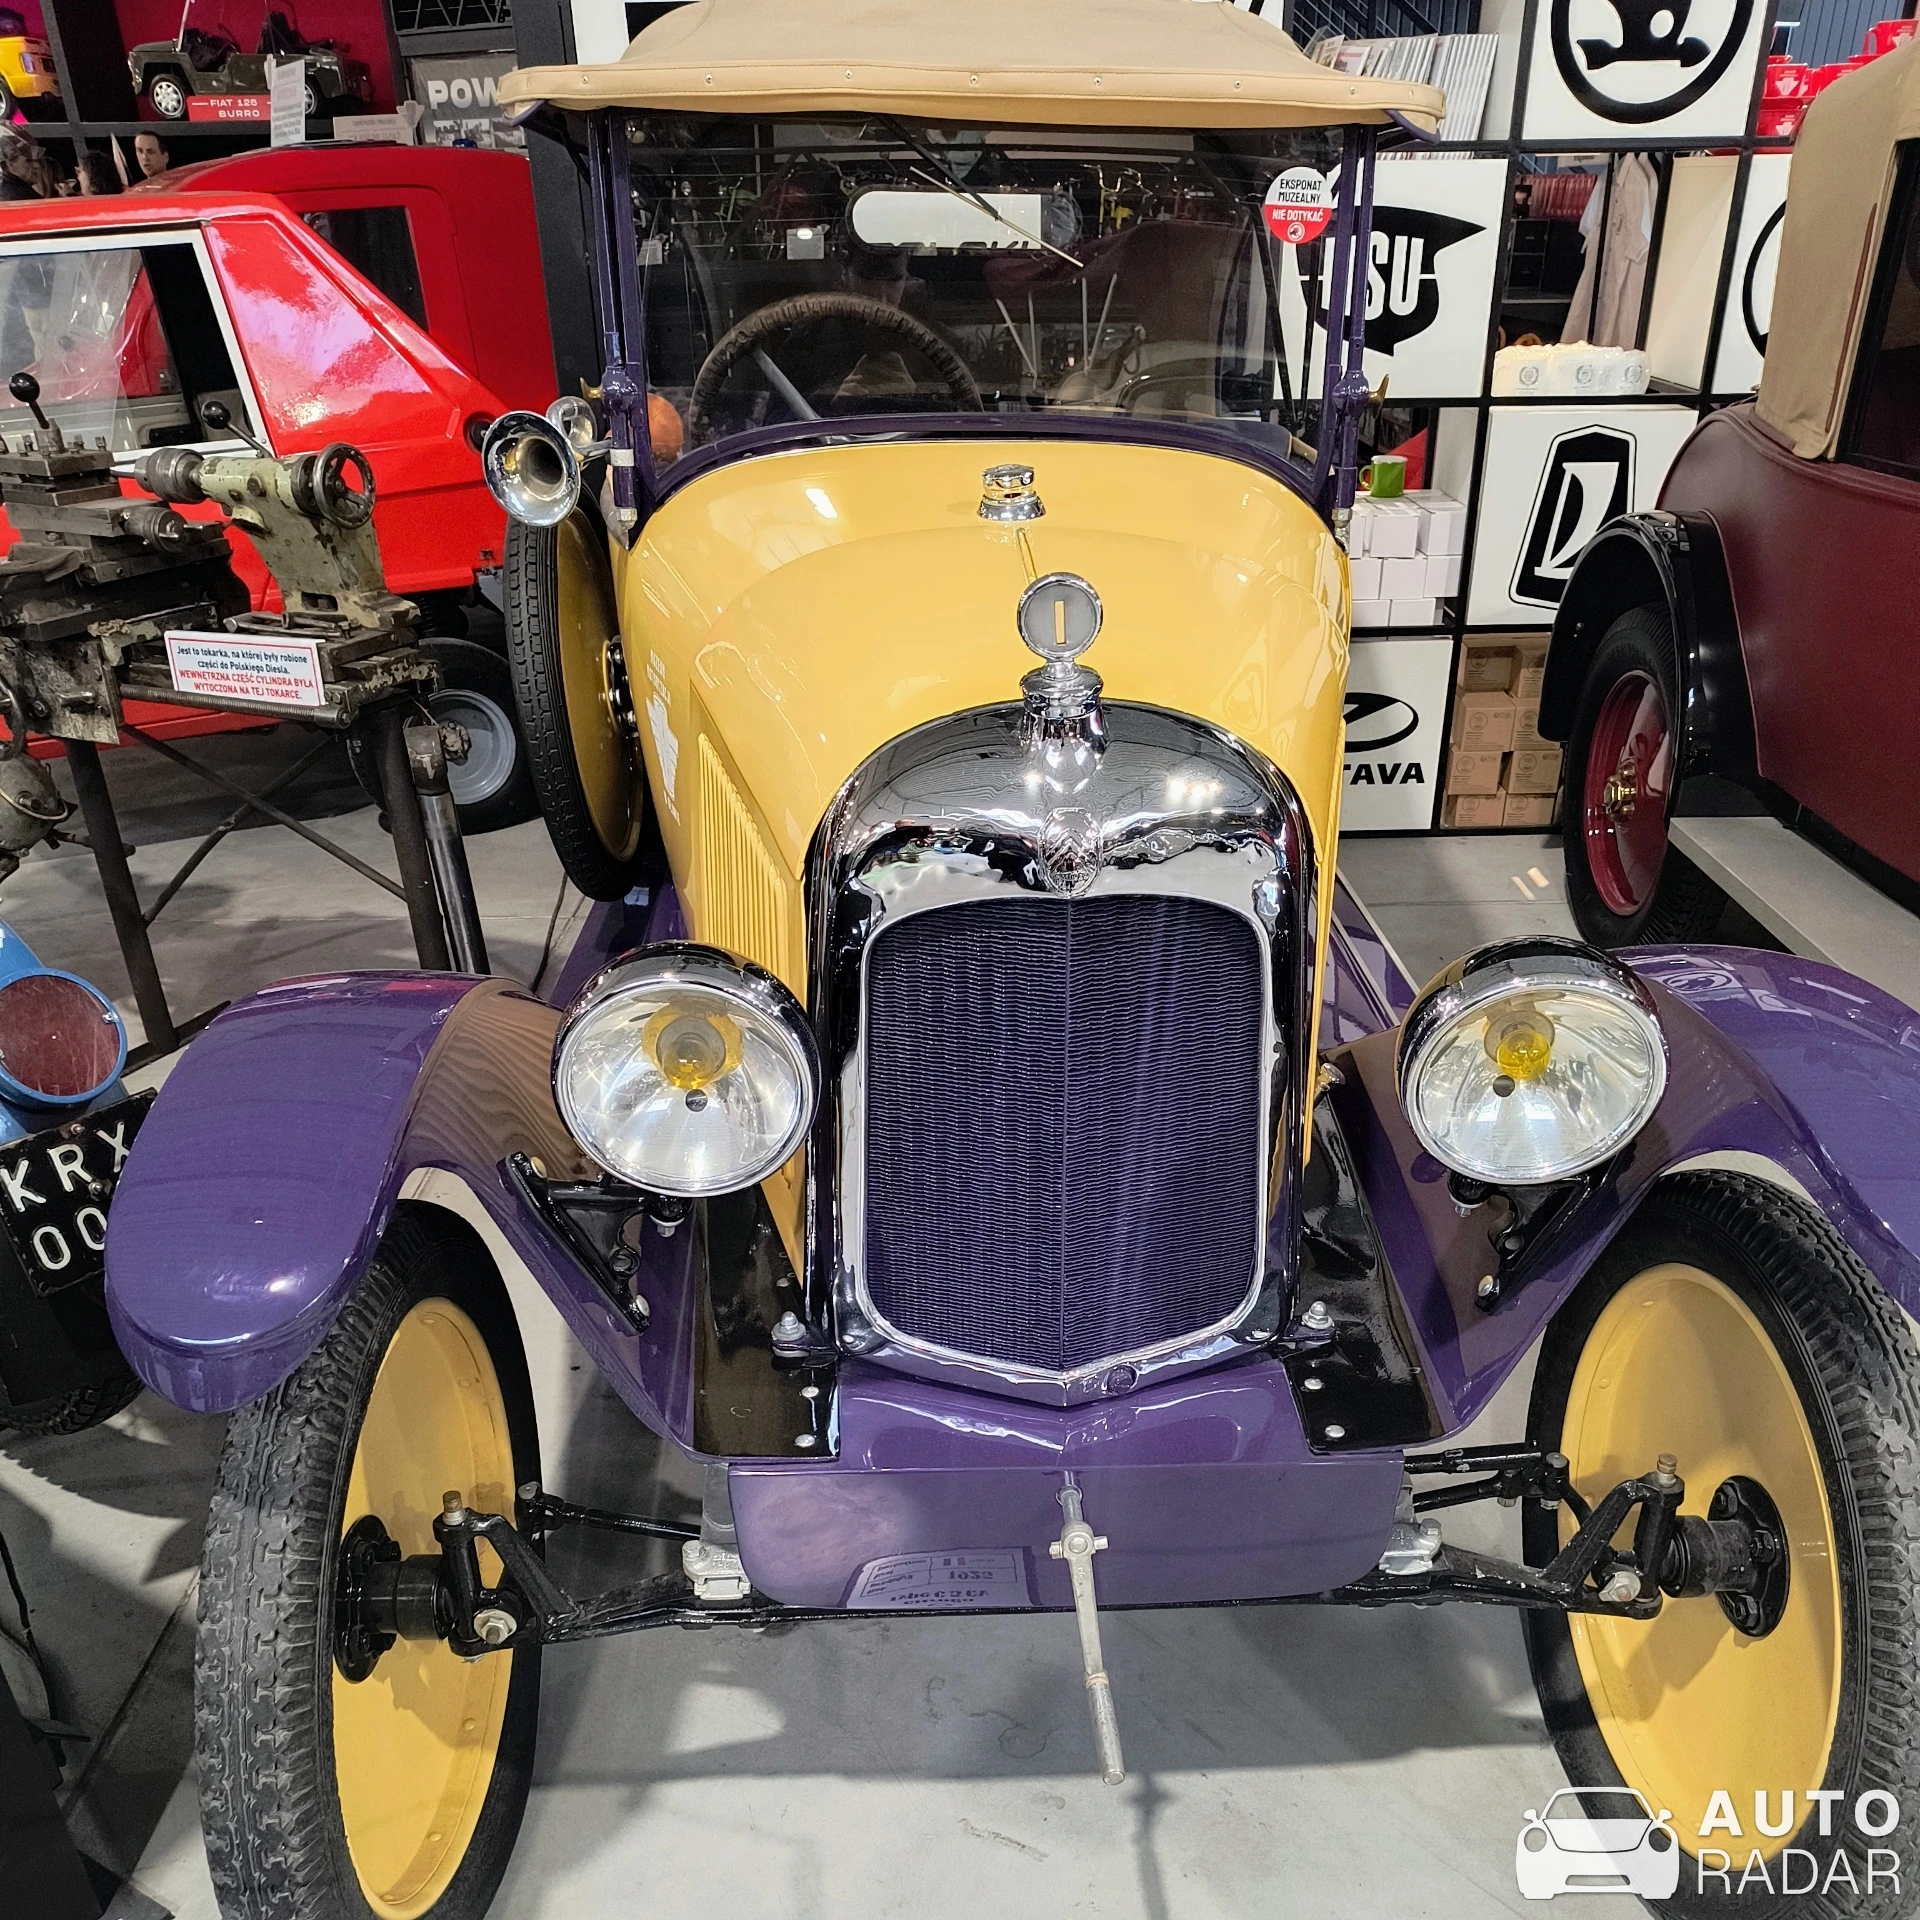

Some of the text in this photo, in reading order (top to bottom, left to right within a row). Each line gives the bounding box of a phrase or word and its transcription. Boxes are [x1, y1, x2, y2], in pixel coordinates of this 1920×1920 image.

[210, 99, 233, 107] FIAT
[1280, 179, 1322, 191] EKSPONAT
[1278, 192, 1321, 204] MUZEALNY
[1272, 209, 1324, 222] NIE DOTYKAĆ
[177, 646, 308, 663] Jest to tokarka, na której były robione
[197, 659, 291, 675] części do Polskiego Diesla.
[179, 669, 314, 688] WEWNĘTRZNA CZĘŚĆ CYLINDRA BYŁA
[194, 682, 303, 699] WYTOCZONA NA TEJ TOKARCE.
[1343, 763, 1425, 785] AVA
[0, 1121, 130, 1213] KRX
[33, 1206, 107, 1270] 00
